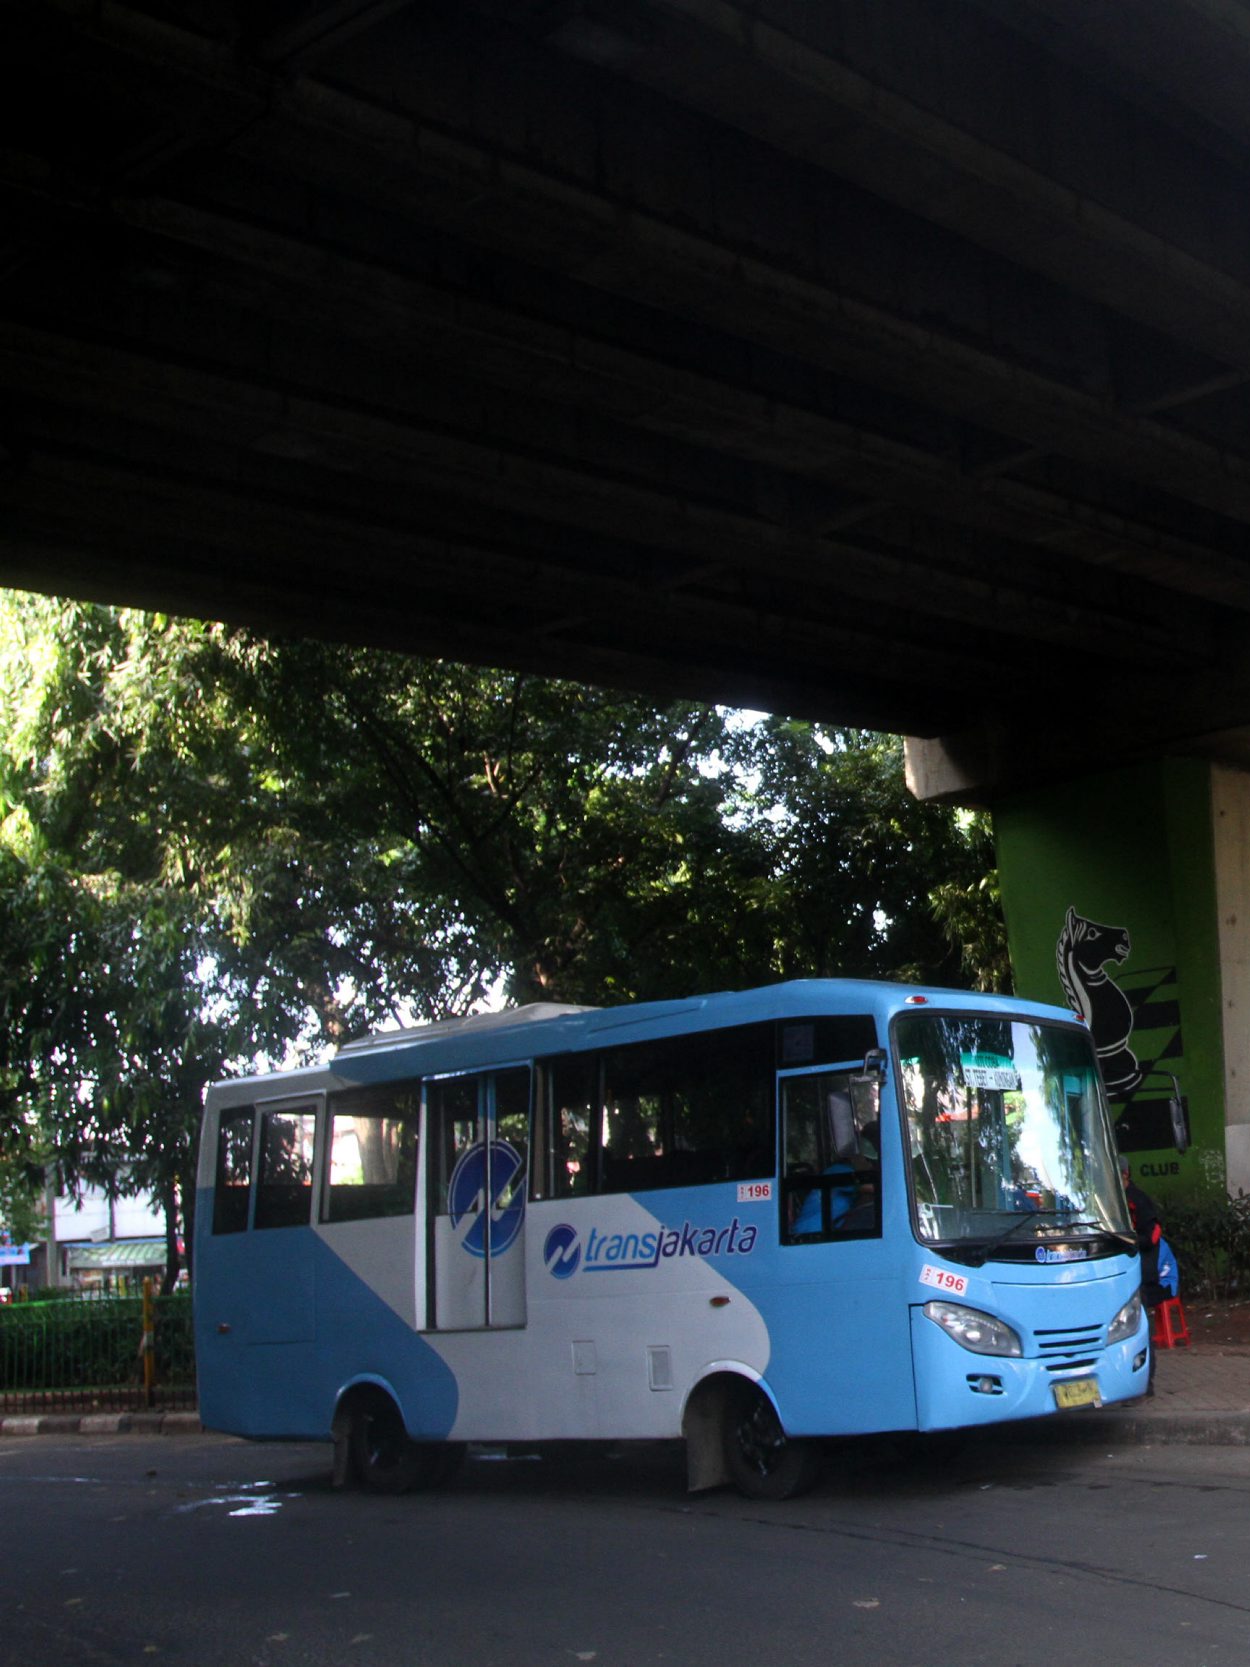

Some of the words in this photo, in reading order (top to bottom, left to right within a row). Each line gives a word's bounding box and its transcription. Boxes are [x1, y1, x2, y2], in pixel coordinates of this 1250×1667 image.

[1140, 1162, 1180, 1177] CLUB
[748, 1184, 769, 1198] 196
[583, 1216, 758, 1273] transjakarta
[936, 1271, 966, 1293] 196
